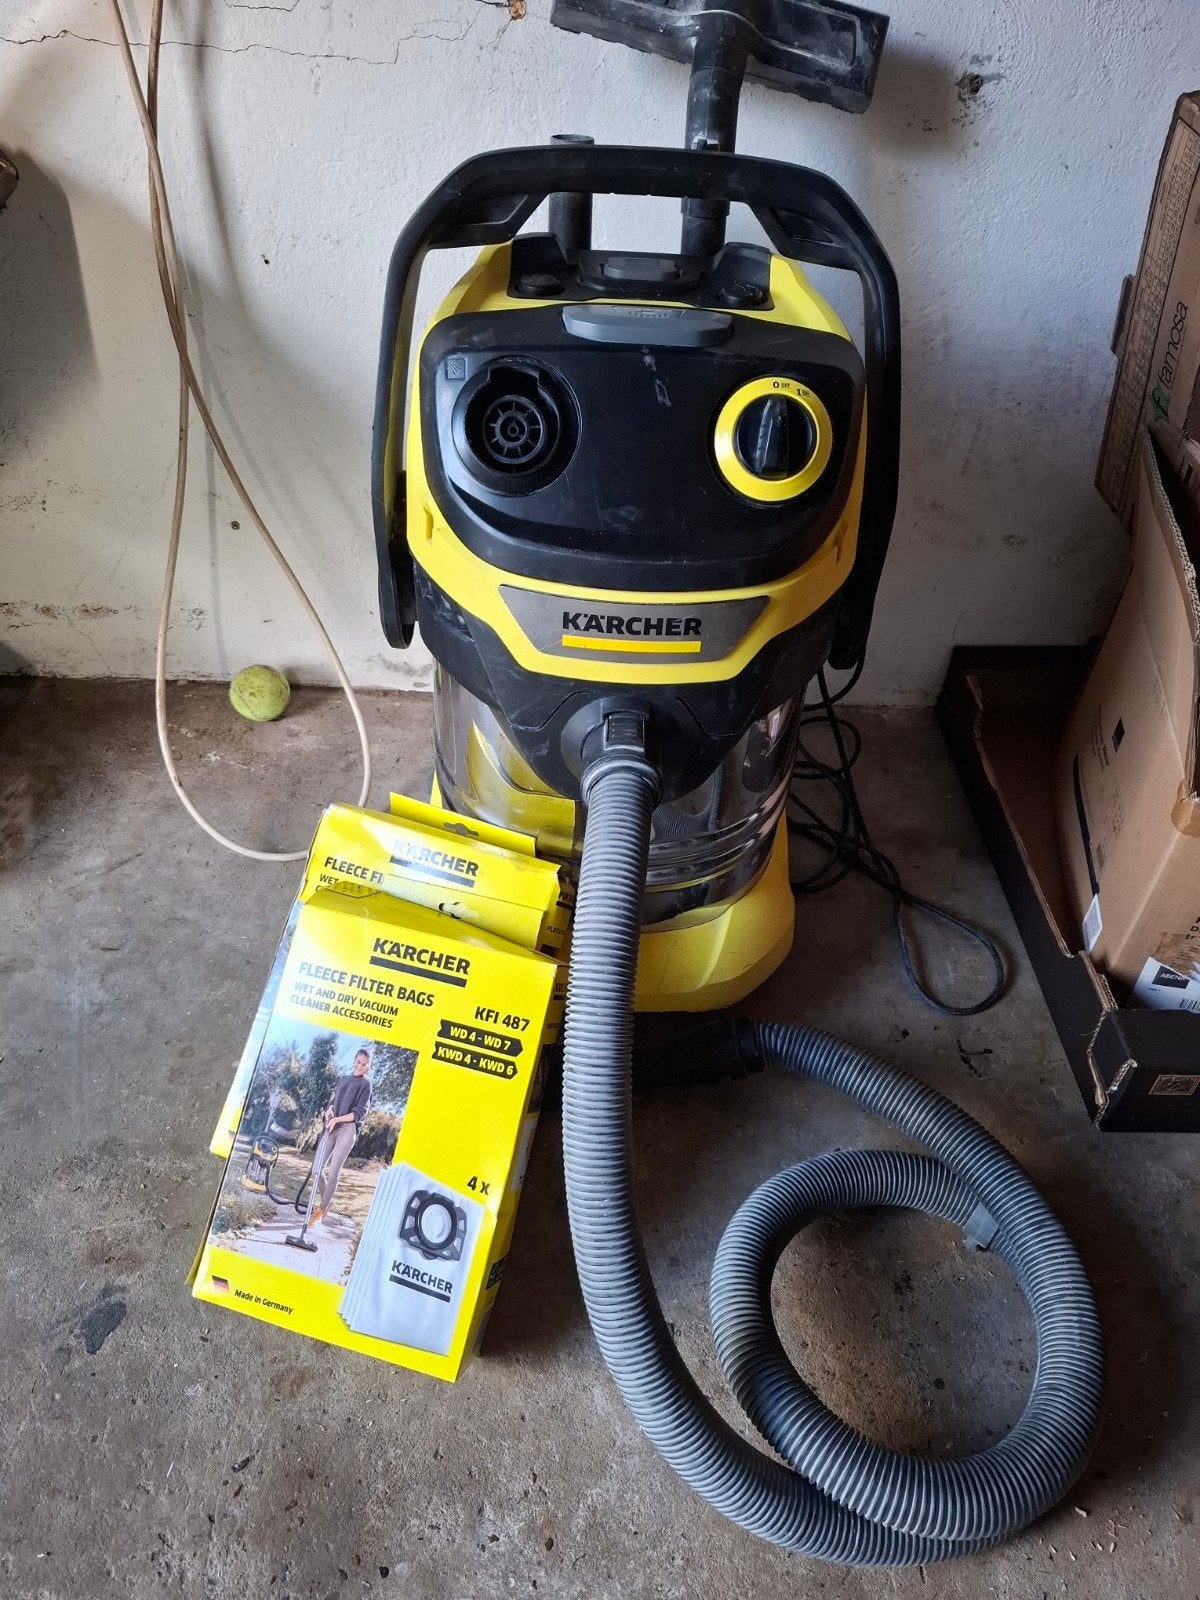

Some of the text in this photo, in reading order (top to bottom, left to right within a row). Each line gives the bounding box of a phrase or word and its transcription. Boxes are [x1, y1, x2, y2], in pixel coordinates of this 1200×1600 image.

[1157, 301, 1188, 389] famosa
[562, 611, 702, 636] KÄRCHER
[324, 856, 370, 880] FLEECE
[372, 937, 471, 975] KÄRCHER
[294, 981, 399, 1017] WET AND DRY VACUUM
[299, 961, 435, 1008] FLEECE FILTER BAGS
[290, 994, 393, 1029] CLEANER ACCESSORIES
[474, 1006, 499, 1024] KFI
[502, 1014, 530, 1031] 487
[450, 1026, 467, 1039] WD
[468, 1032, 476, 1042] 4
[484, 1034, 501, 1049] WD
[503, 1041, 511, 1051] 7
[437, 1046, 463, 1062] KWD
[464, 1054, 471, 1064] 4
[479, 1058, 505, 1073] KWD
[506, 1065, 514, 1076] 6
[467, 1176, 478, 1191] 4
[391, 1260, 453, 1294] KÄRCHER
[234, 1289, 294, 1315] Made in Germany
